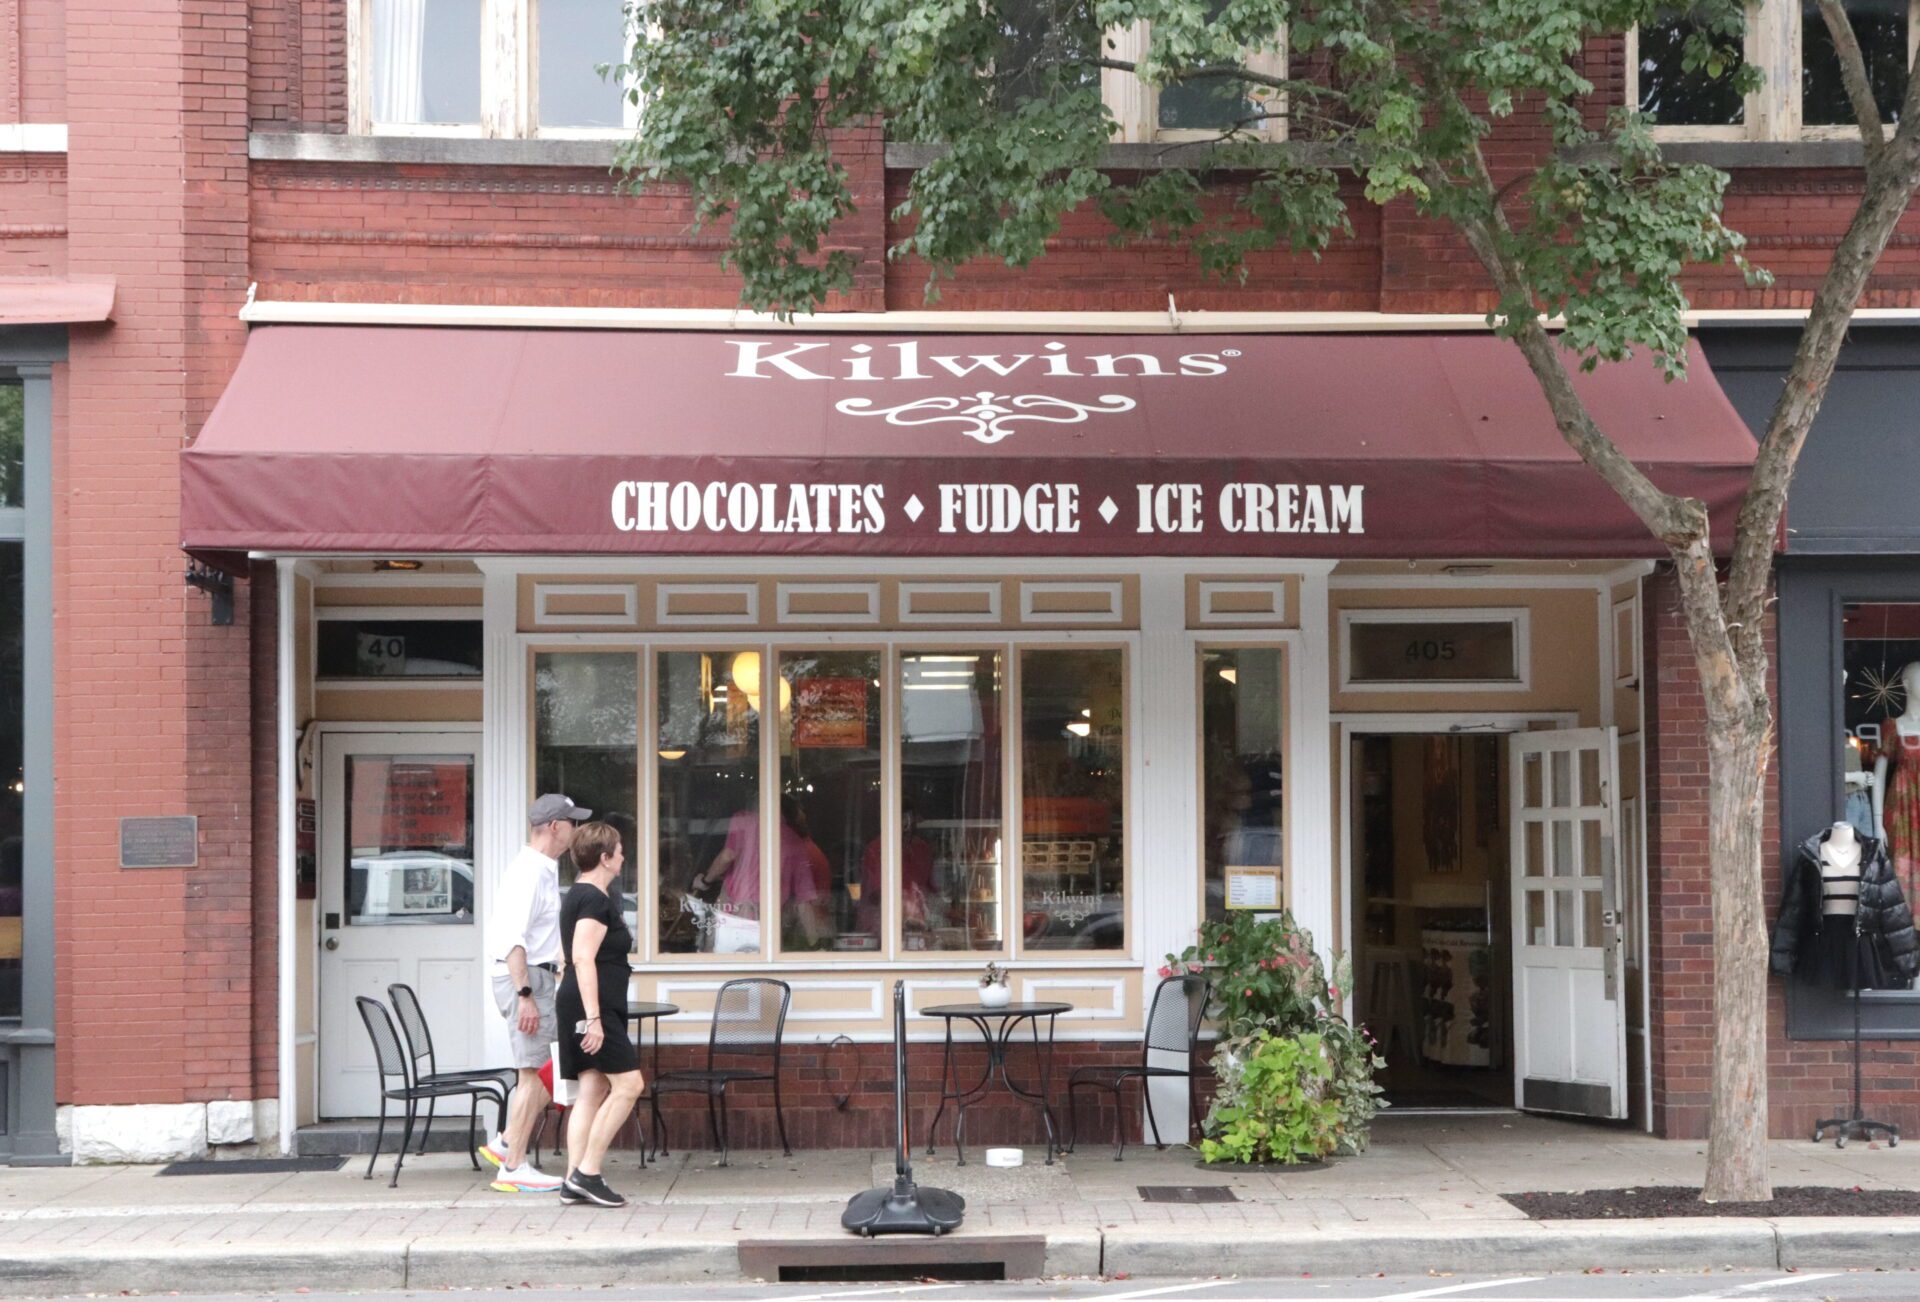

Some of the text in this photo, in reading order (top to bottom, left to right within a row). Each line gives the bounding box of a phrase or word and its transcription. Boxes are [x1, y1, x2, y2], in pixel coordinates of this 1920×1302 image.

[611, 480, 1364, 535] CHOCOLATES FUDGE ICE CREAM
[1405, 640, 1456, 661] 405
[1042, 890, 1104, 905] Kilwins
